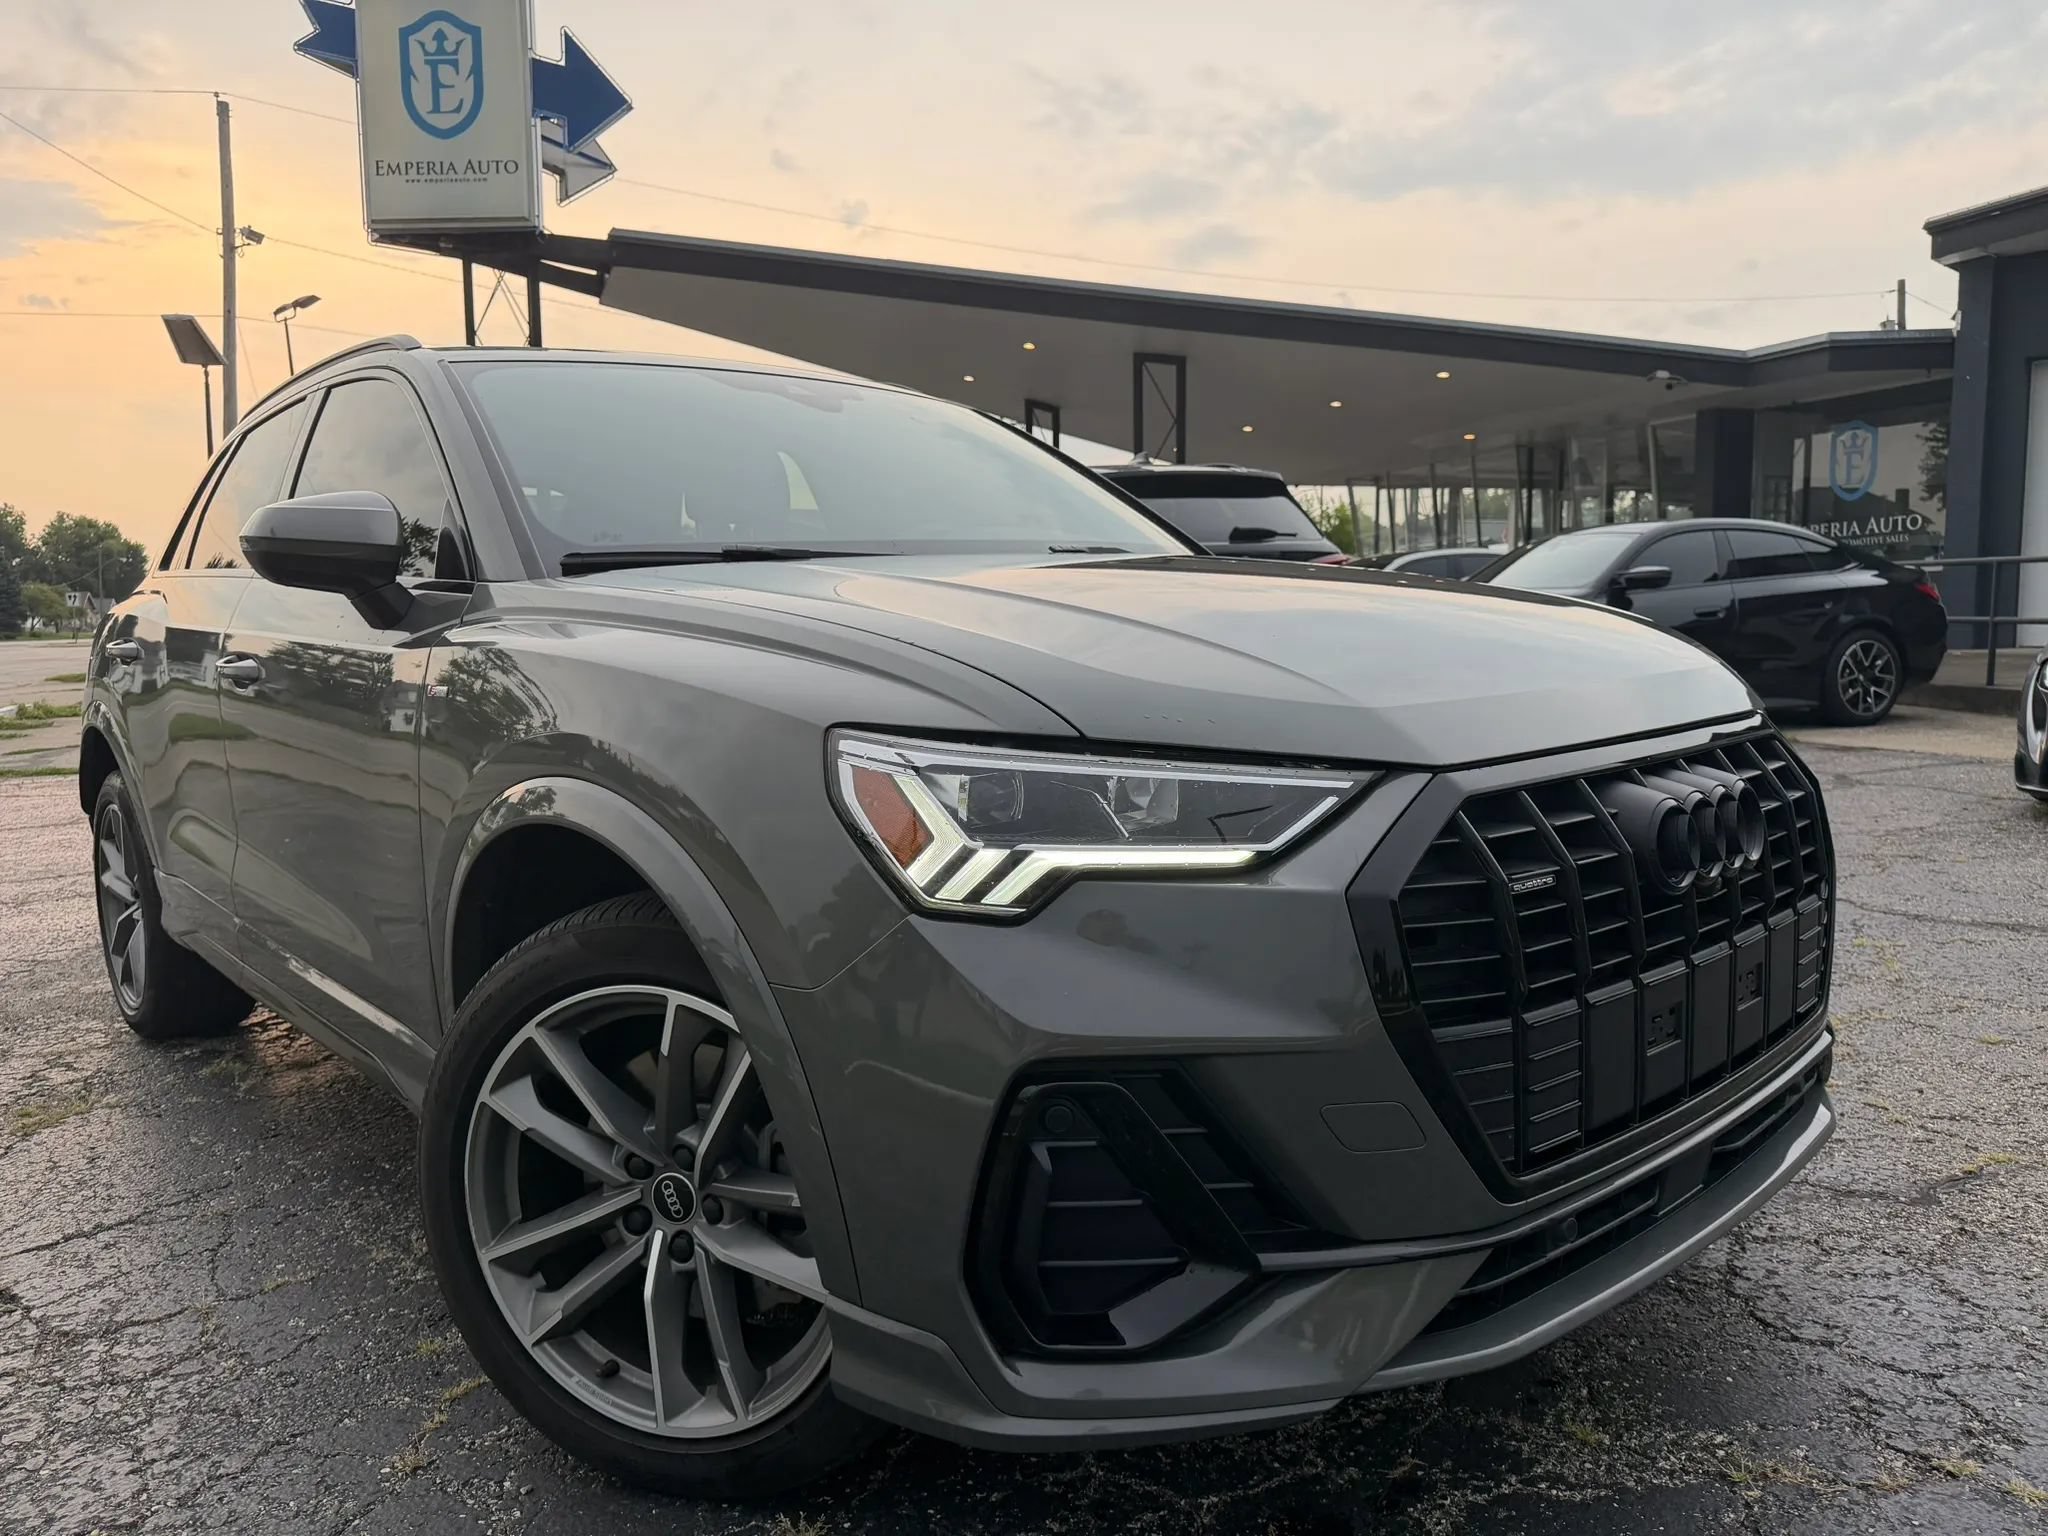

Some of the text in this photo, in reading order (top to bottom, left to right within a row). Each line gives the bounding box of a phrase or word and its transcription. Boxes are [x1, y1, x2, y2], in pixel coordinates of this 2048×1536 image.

[424, 59, 464, 114] E
[375, 158, 519, 177] EMPERIA AUTO
[1804, 514, 1922, 537] PERIA AUTO
[1513, 877, 1554, 892] quattro
